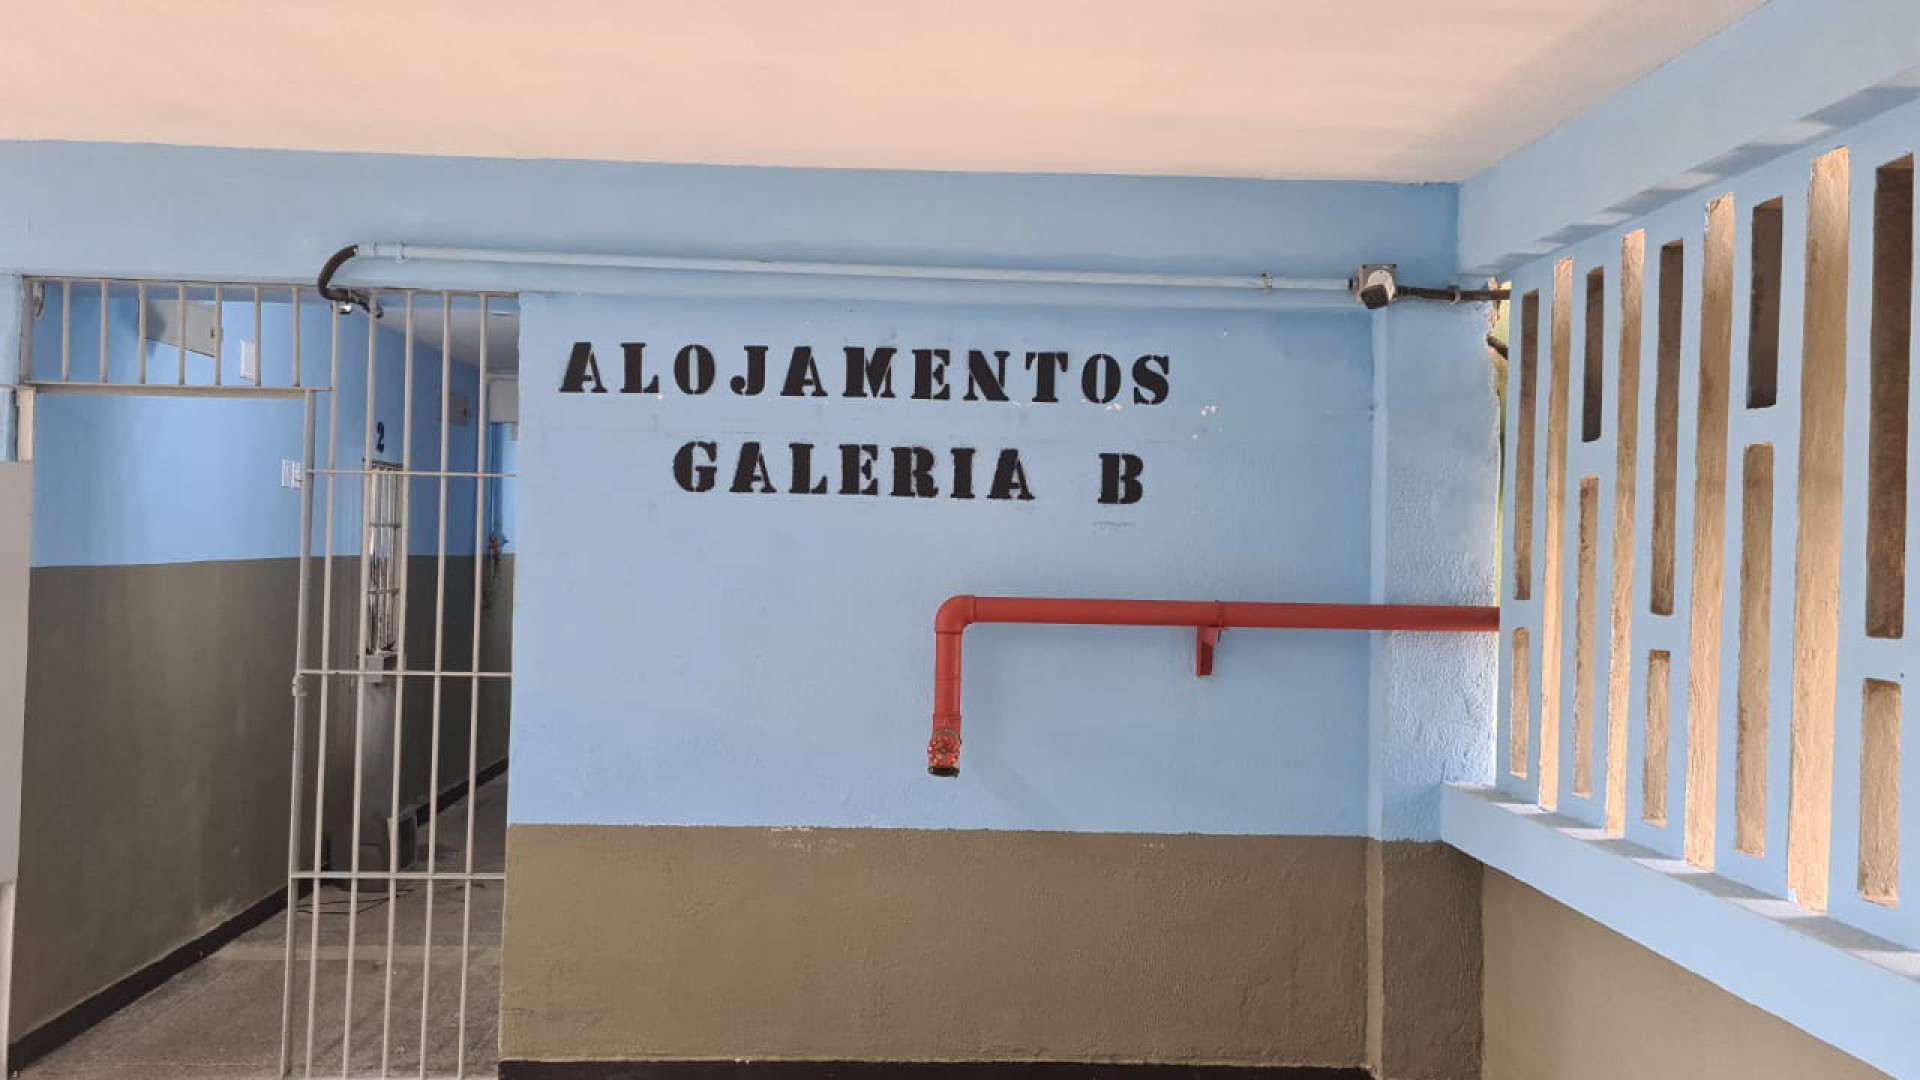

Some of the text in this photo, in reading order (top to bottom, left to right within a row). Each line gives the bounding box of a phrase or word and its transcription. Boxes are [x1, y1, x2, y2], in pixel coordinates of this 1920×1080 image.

[559, 341, 1171, 406] ALOJAMENTOS
[375, 420, 385, 454] 2
[672, 441, 1145, 505] GALERIA B
